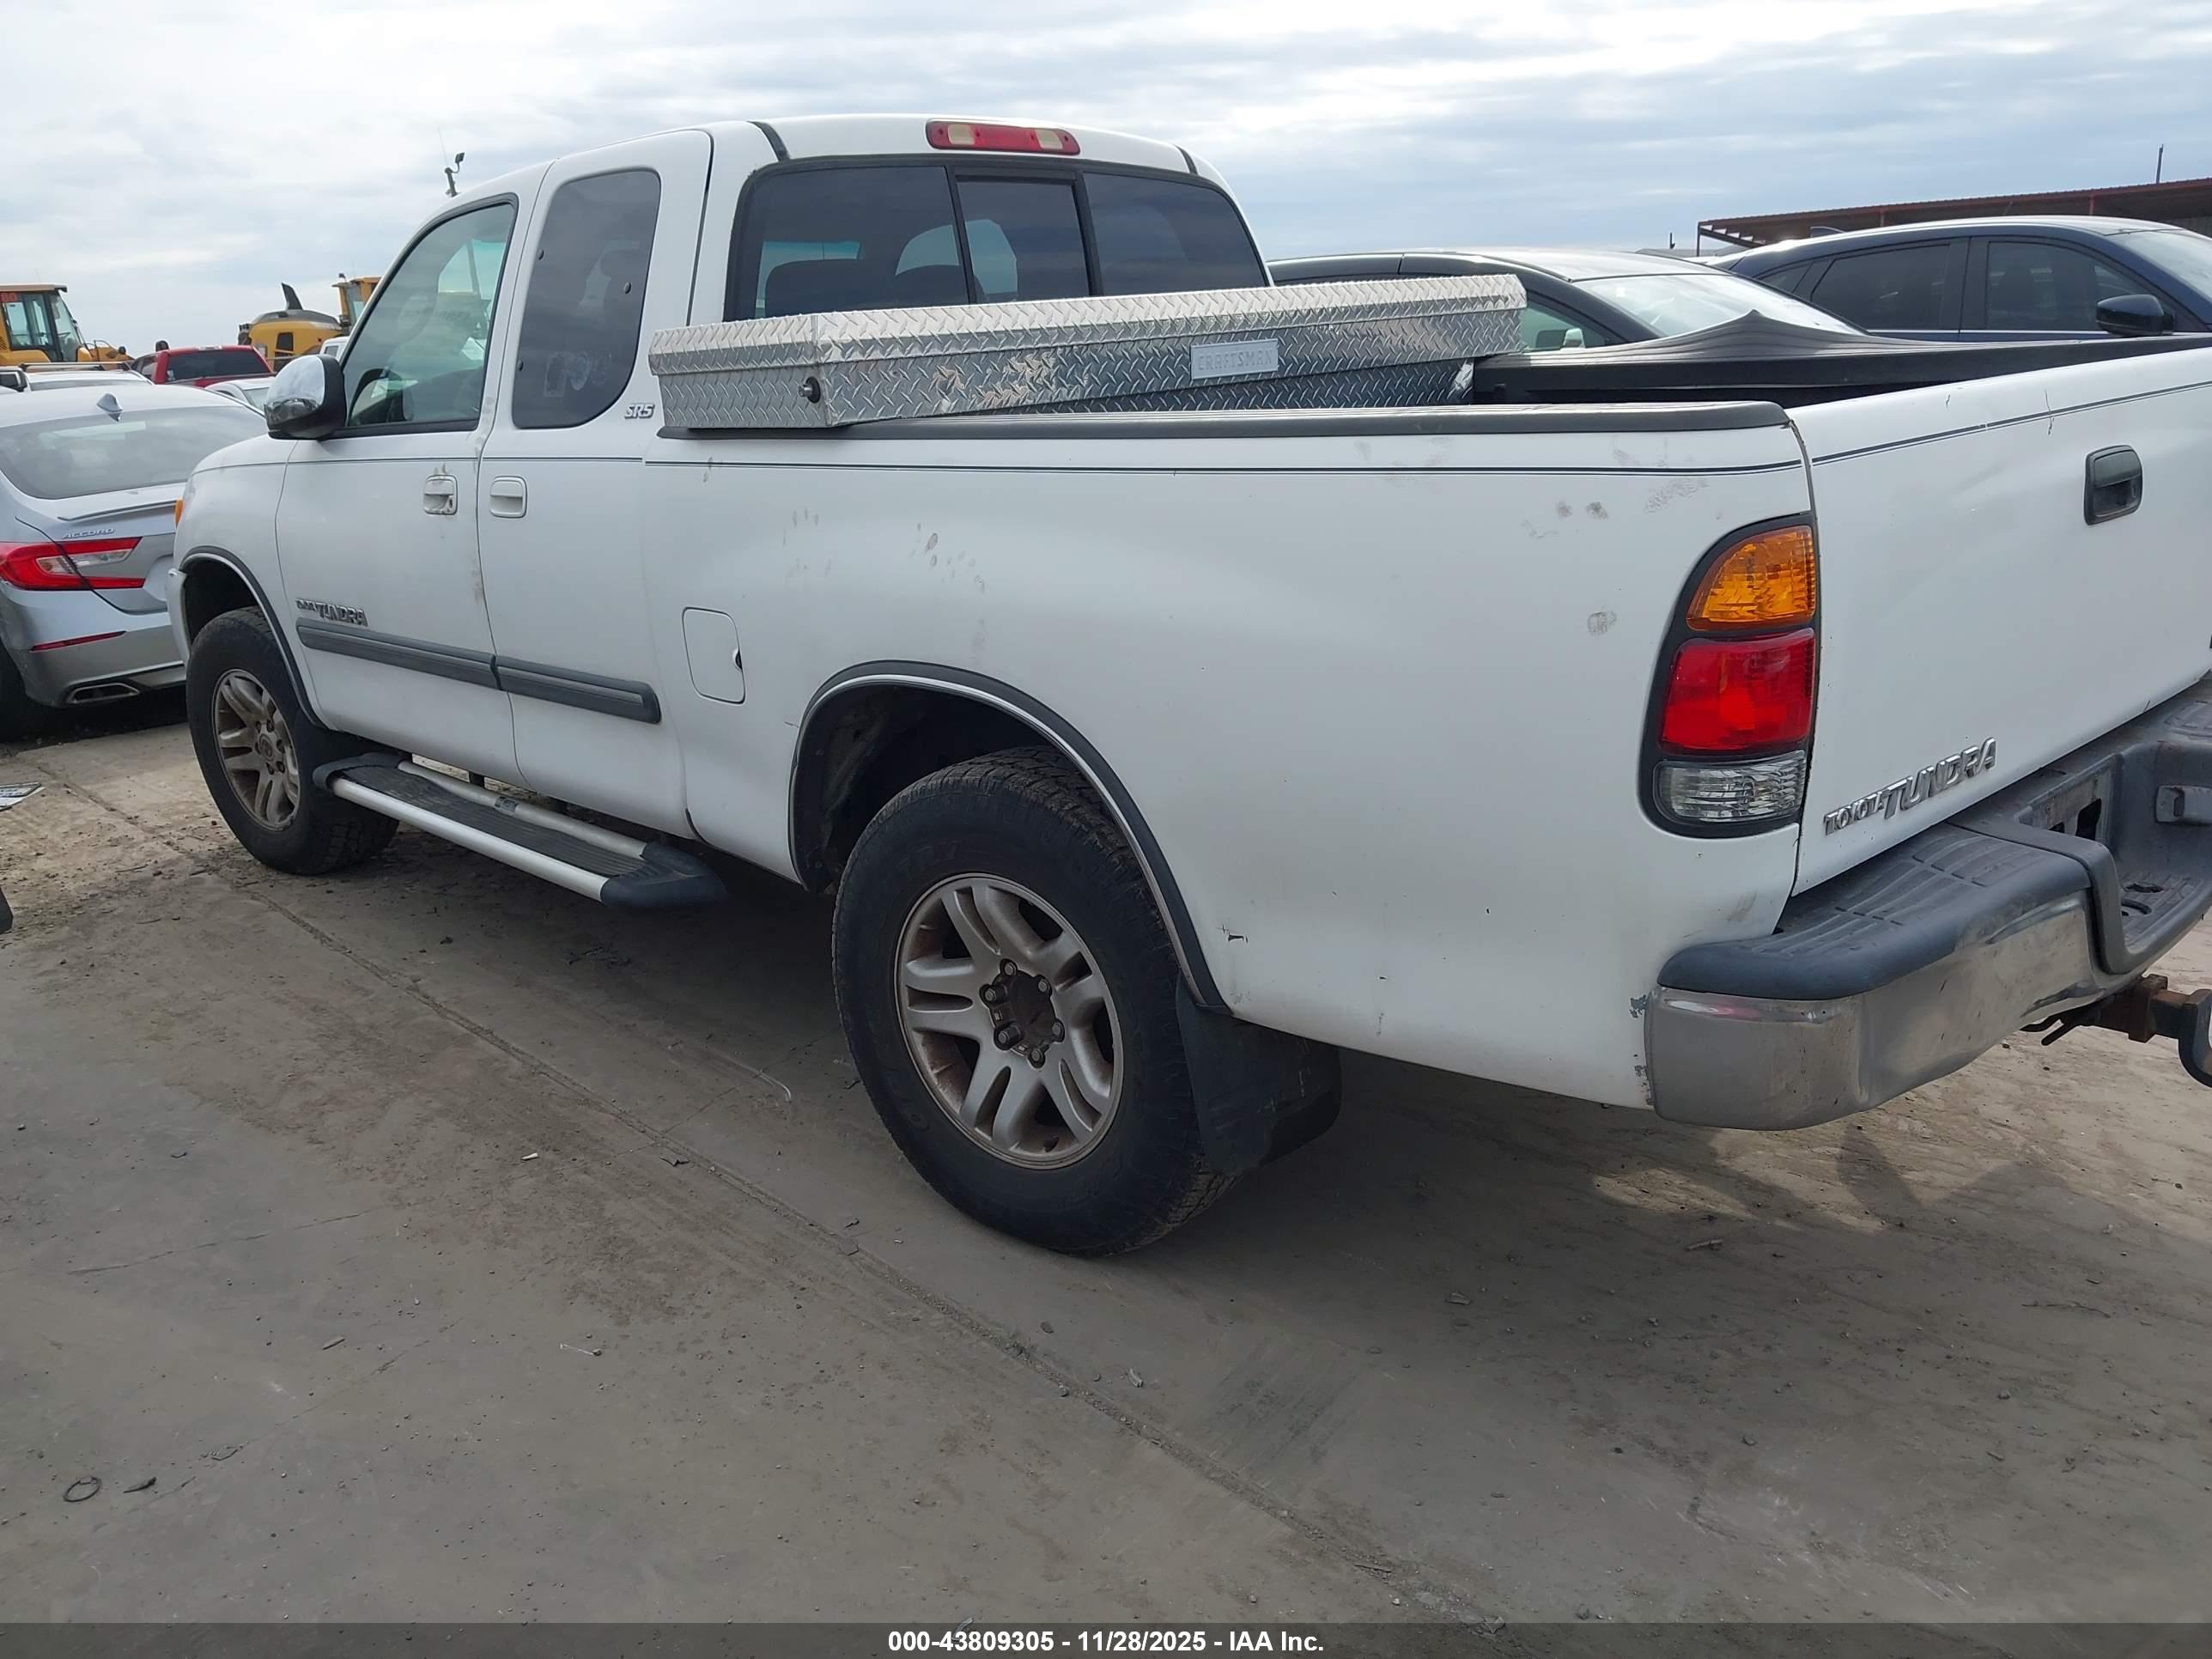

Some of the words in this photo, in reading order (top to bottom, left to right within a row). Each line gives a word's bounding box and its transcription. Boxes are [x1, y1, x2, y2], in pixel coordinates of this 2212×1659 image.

[1198, 348, 1273, 372] CRAFTSMAN
[61, 527, 115, 540] ACCORD
[316, 602, 368, 626] TUNDRA
[1823, 790, 1884, 836] TOYOTA
[1881, 737, 1996, 820] TUNDRA
